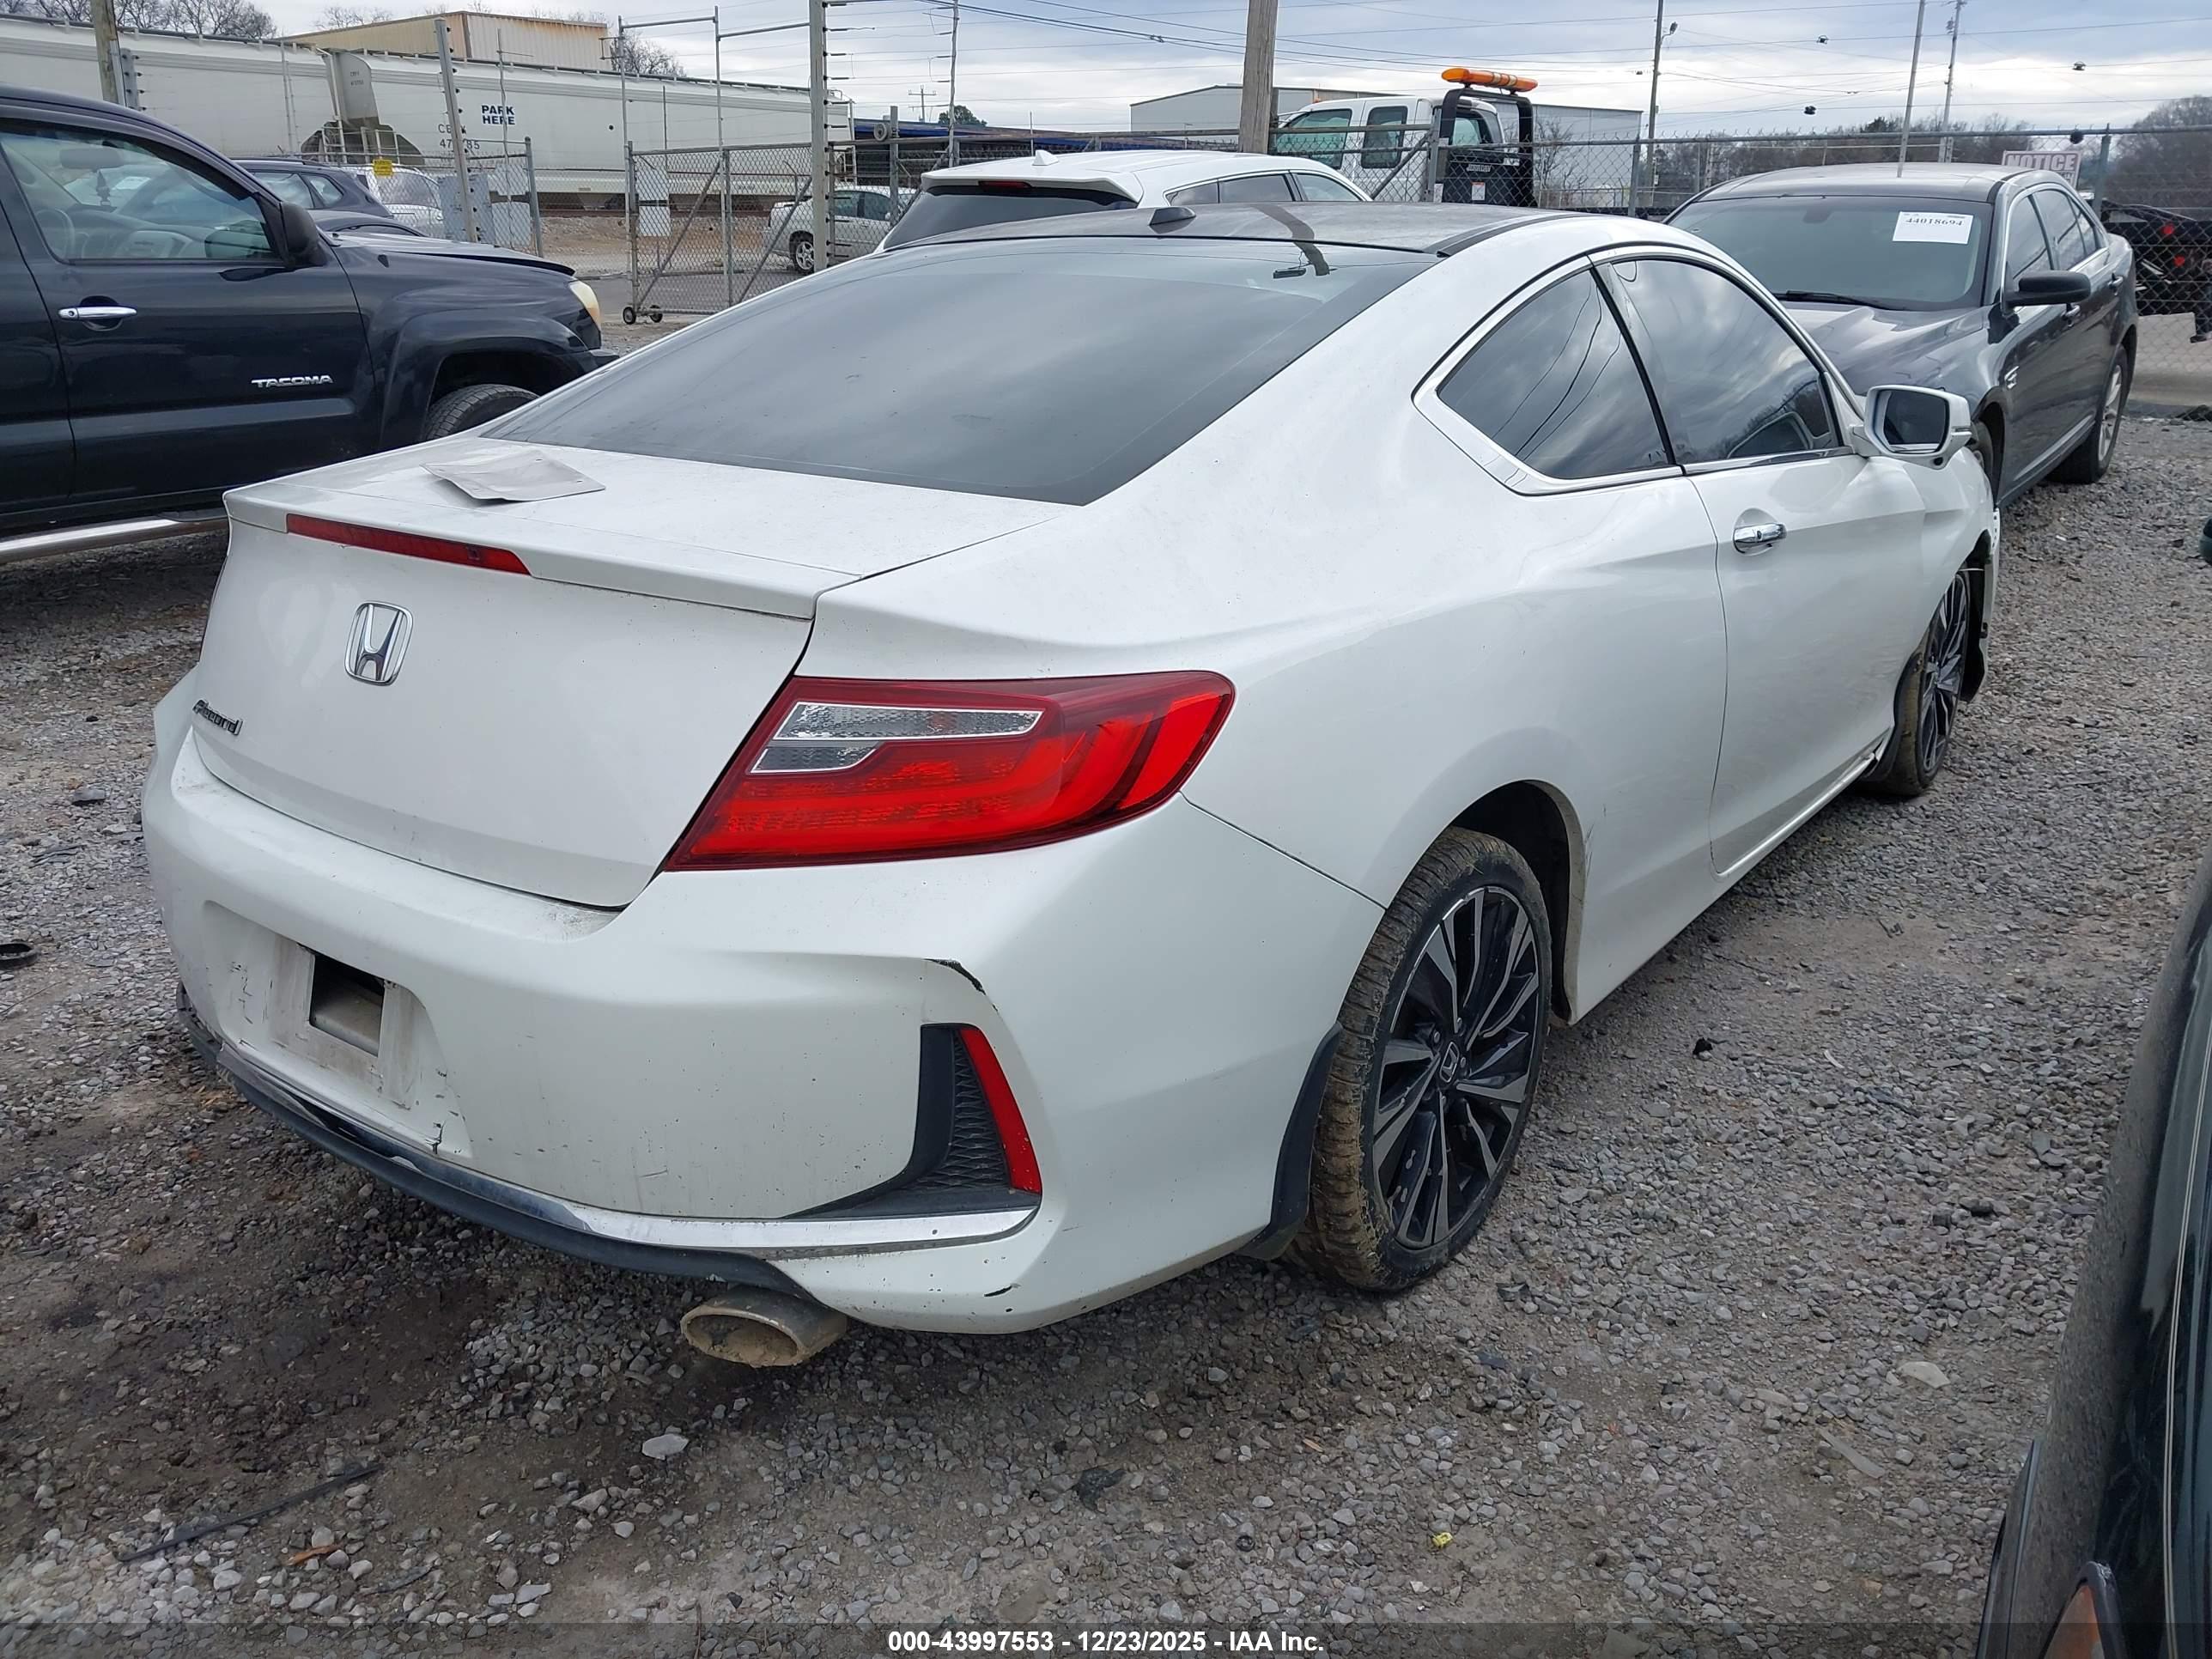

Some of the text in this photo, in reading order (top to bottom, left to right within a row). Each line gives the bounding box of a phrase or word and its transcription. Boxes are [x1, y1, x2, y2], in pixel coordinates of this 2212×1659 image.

[2007, 155, 2076, 171] NOTICE
[251, 374, 333, 387] TACOMA
[191, 699, 244, 736] Accord
